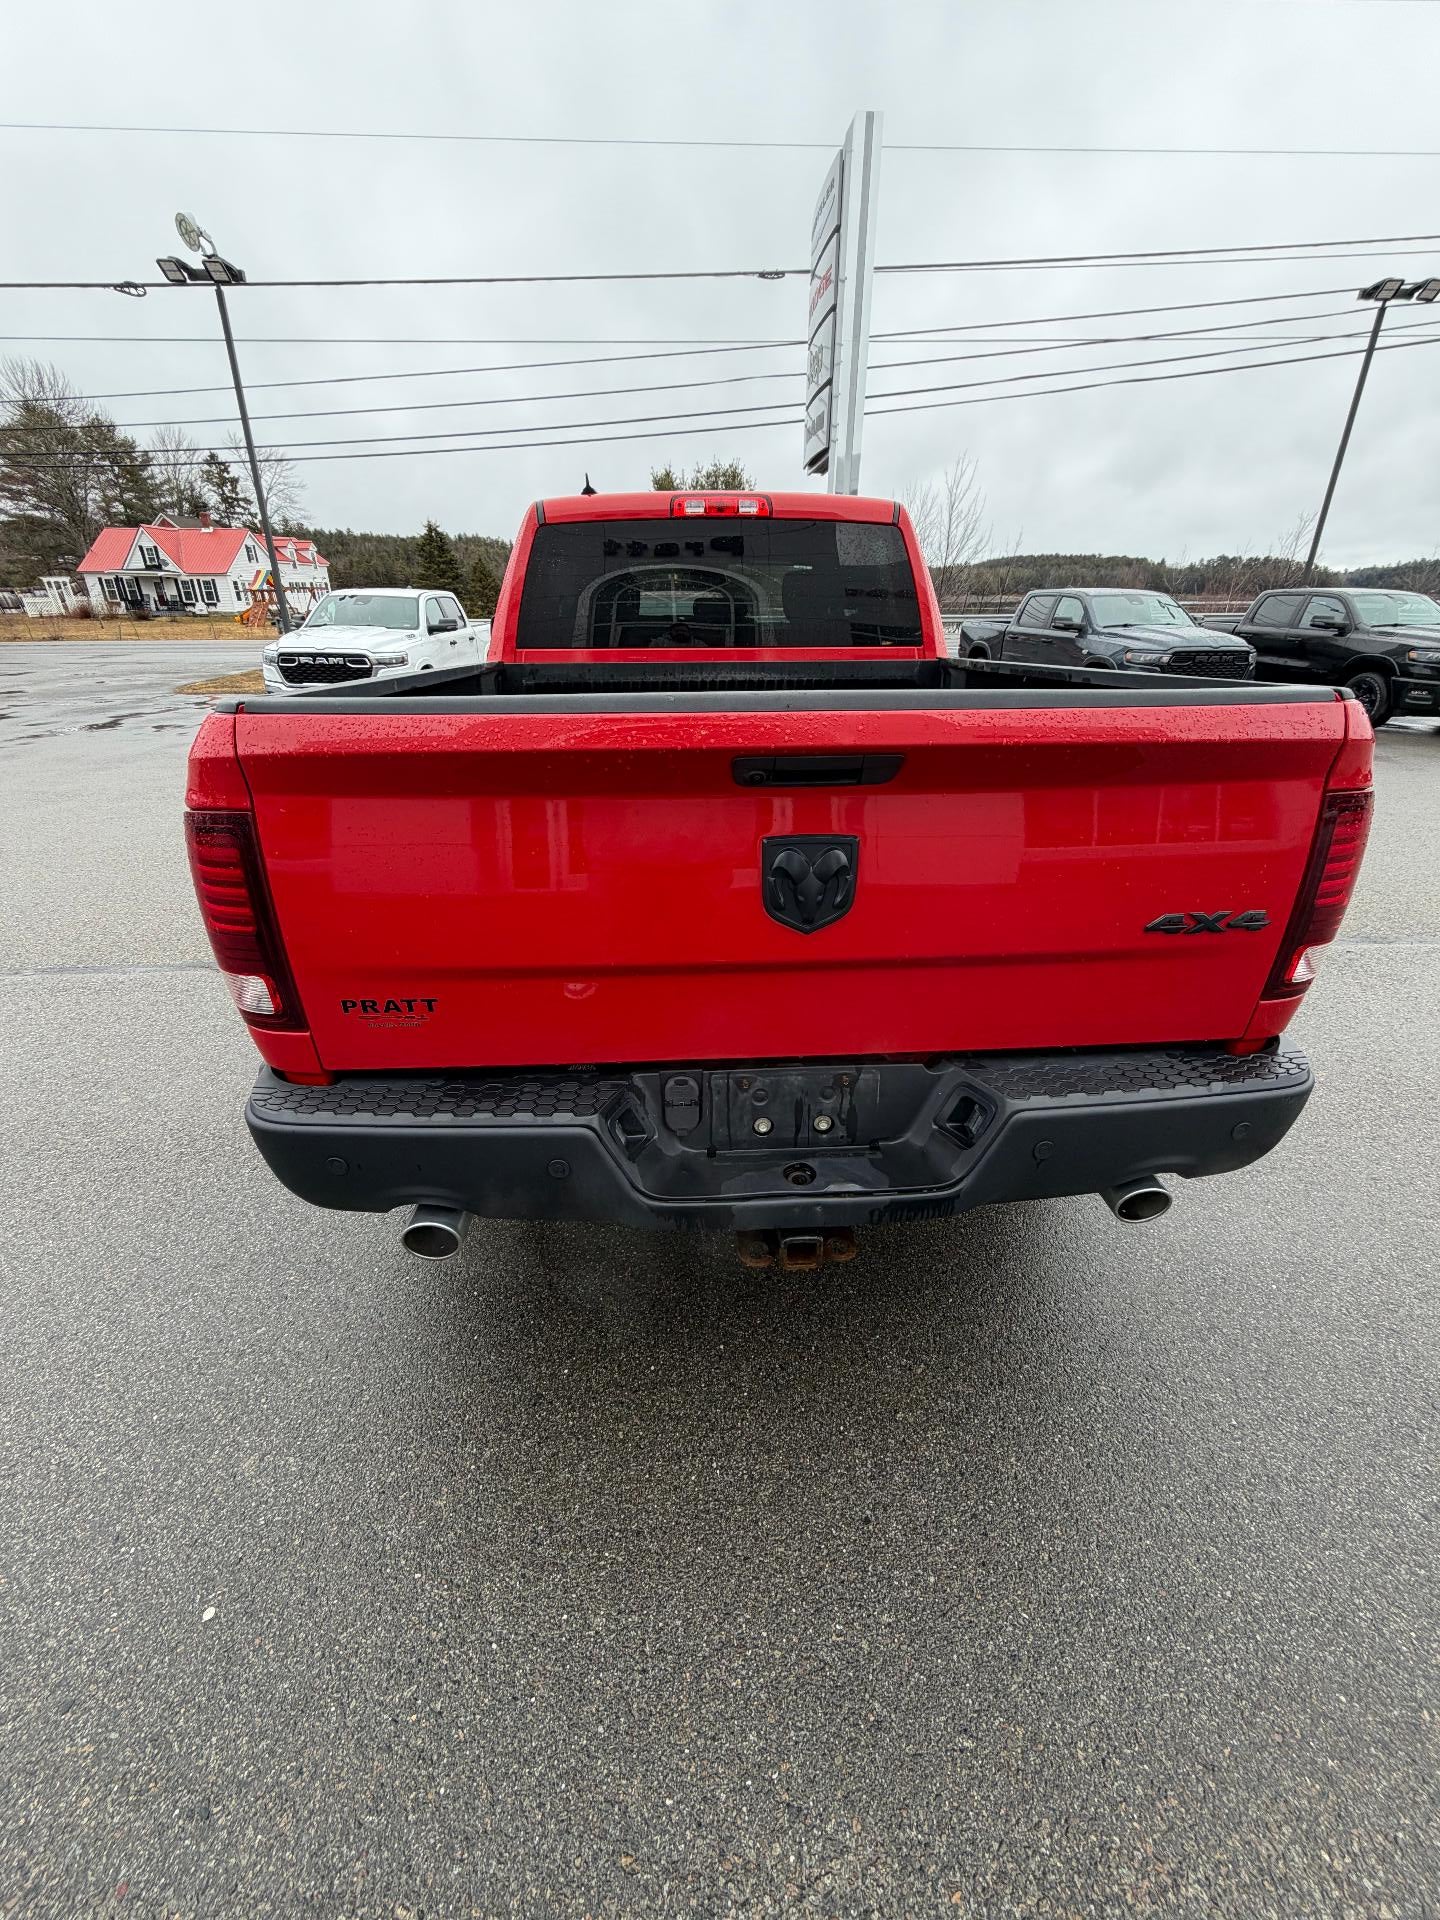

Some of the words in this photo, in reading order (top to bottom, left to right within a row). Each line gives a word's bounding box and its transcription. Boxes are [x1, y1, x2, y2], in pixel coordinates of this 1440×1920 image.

[299, 656, 345, 665] RAM
[1194, 655, 1235, 663] RAM
[341, 998, 439, 1014] PRATT
